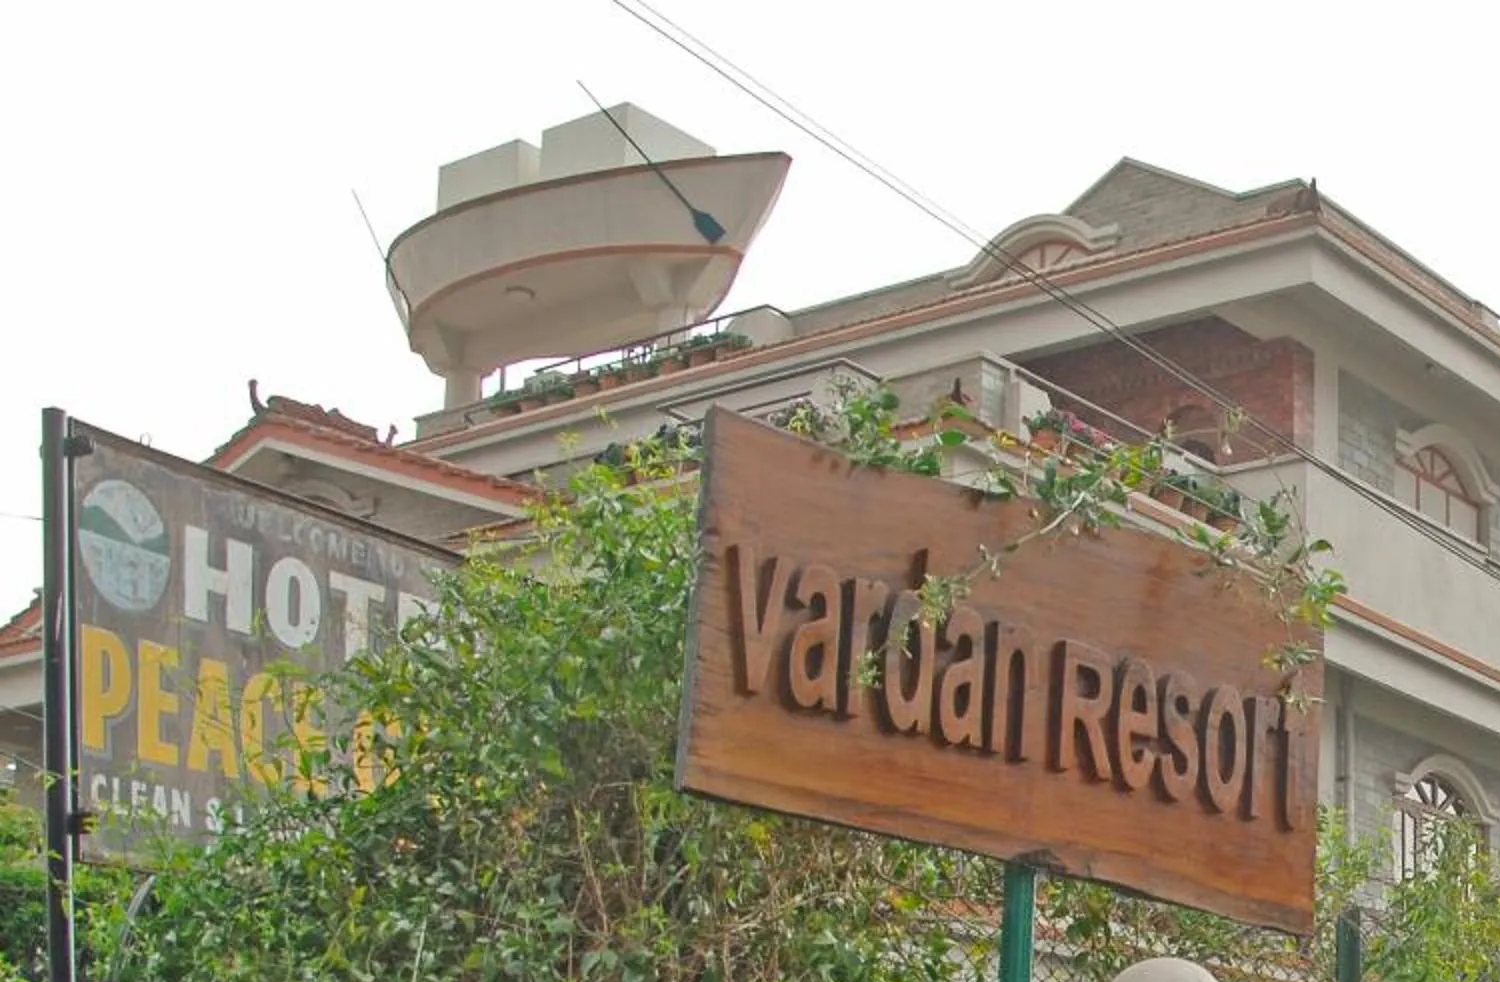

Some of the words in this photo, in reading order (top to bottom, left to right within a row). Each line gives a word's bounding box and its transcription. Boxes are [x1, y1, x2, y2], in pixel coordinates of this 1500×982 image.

[727, 543, 1038, 763] Vardan
[1048, 638, 1314, 833] Resort
[90, 772, 192, 830] CLEAN
